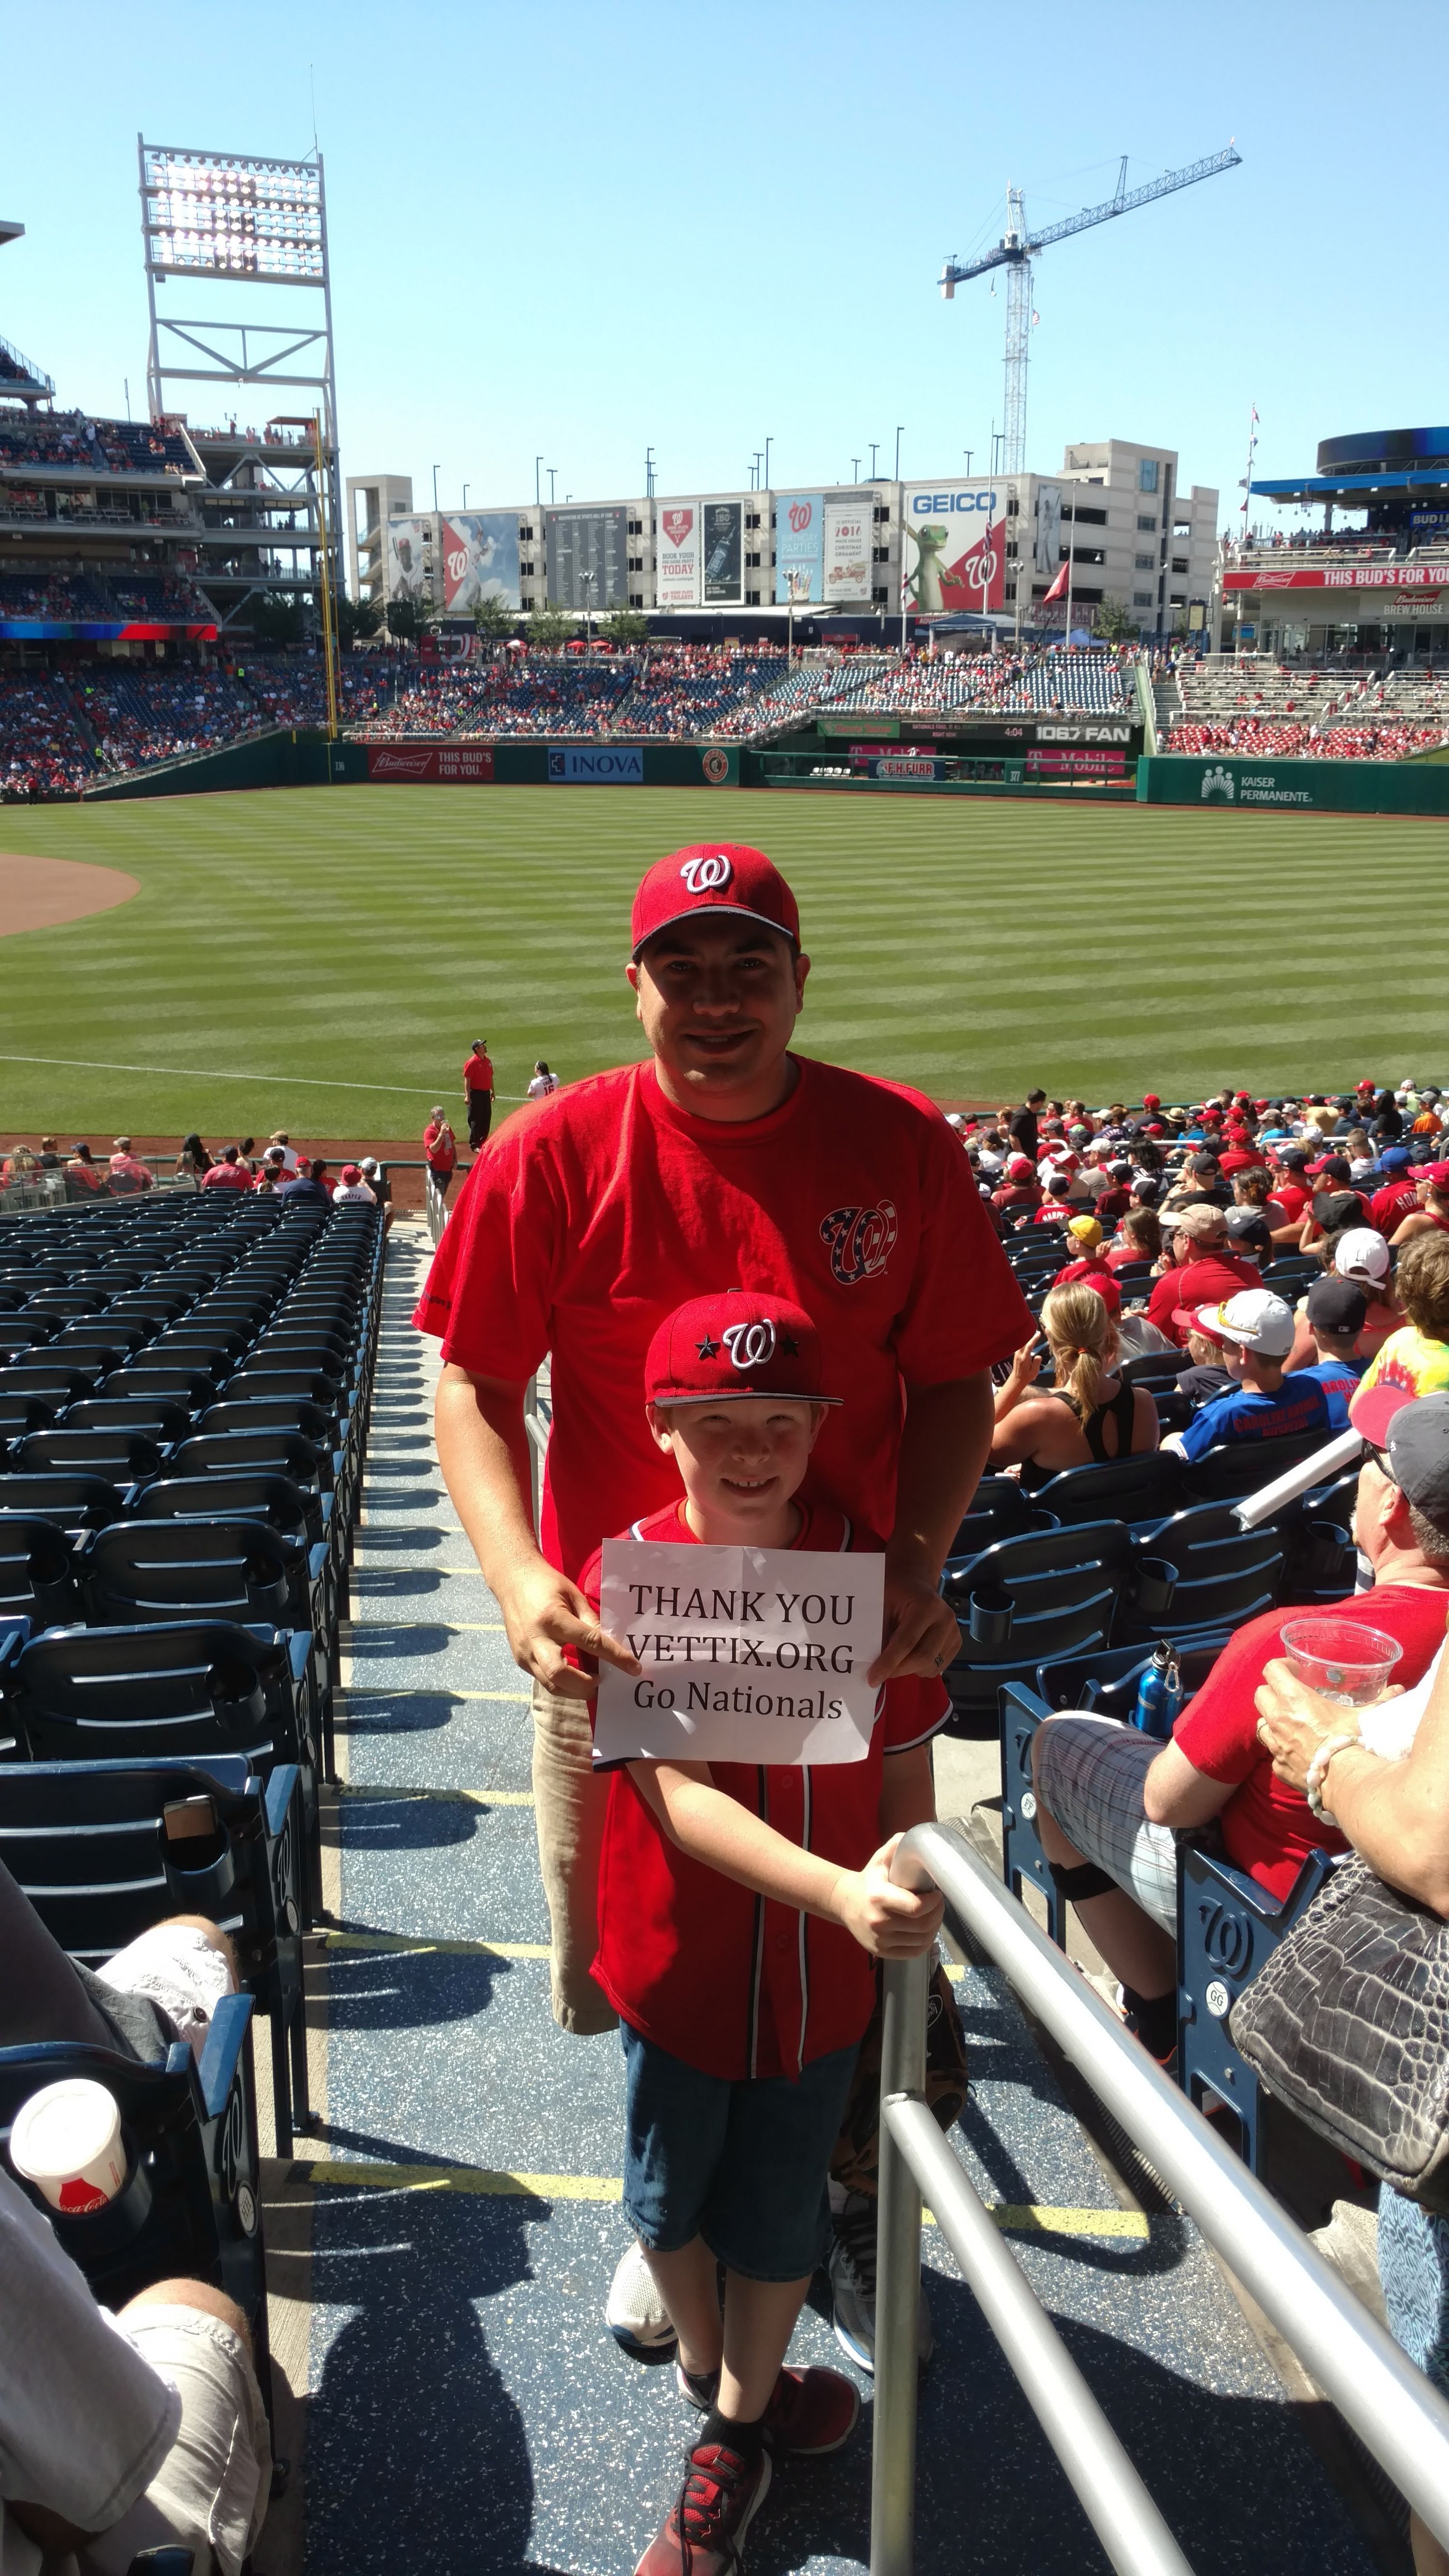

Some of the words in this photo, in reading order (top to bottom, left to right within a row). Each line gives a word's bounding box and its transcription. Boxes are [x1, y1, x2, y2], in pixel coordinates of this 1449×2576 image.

[913, 492, 996, 513] GEICO
[1413, 515, 1437, 525] BUD
[781, 533, 818, 542] BIRTHDAY
[835, 526, 862, 537] 2016
[781, 542, 818, 554] PARTIES
[662, 564, 695, 575] TODAY
[1256, 575, 1294, 584] Budweiser
[1323, 570, 1352, 586] THIS
[1355, 569, 1396, 585] BUD'S
[1398, 569, 1425, 584] FOR
[1395, 594, 1436, 605] Budweiser
[1383, 605, 1413, 615] BREW
[1414, 604, 1445, 615] HOUSE
[1005, 727, 1023, 737] 4:04
[1037, 726, 1081, 740] 106.7
[1086, 727, 1130, 741] FAN
[377, 756, 427, 768] Budweiser
[439, 752, 460, 763] THIS
[462, 752, 492, 763] BUD'S
[1060, 753, 1114, 772] Mobile
[335, 761, 345, 771] 336
[439, 765, 457, 775] FOR
[460, 765, 482, 775] YOU.
[572, 755, 641, 773] INOVA
[1010, 771, 1021, 782] 377
[1241, 776, 1275, 787] KAISER
[1240, 790, 1310, 802] PERMANENTE
[680, 854, 731, 894] W
[723, 1318, 777, 1370] W
[1234, 1409, 1285, 1433] CAROLINE
[1262, 1416, 1308, 1437] HOSPITAL
[629, 1584, 766, 1622] THANK
[775, 1593, 855, 1625] YOU
[625, 1634, 853, 1674] VETTIX.ORG
[634, 1680, 675, 1709] Go
[686, 1681, 843, 1720] Nationals
[1023, 1798, 1034, 1811] FF
[1210, 1989, 1224, 2007] GG
[61, 2193, 107, 2213] Coca-Cola
[242, 2194, 252, 2224] HH
